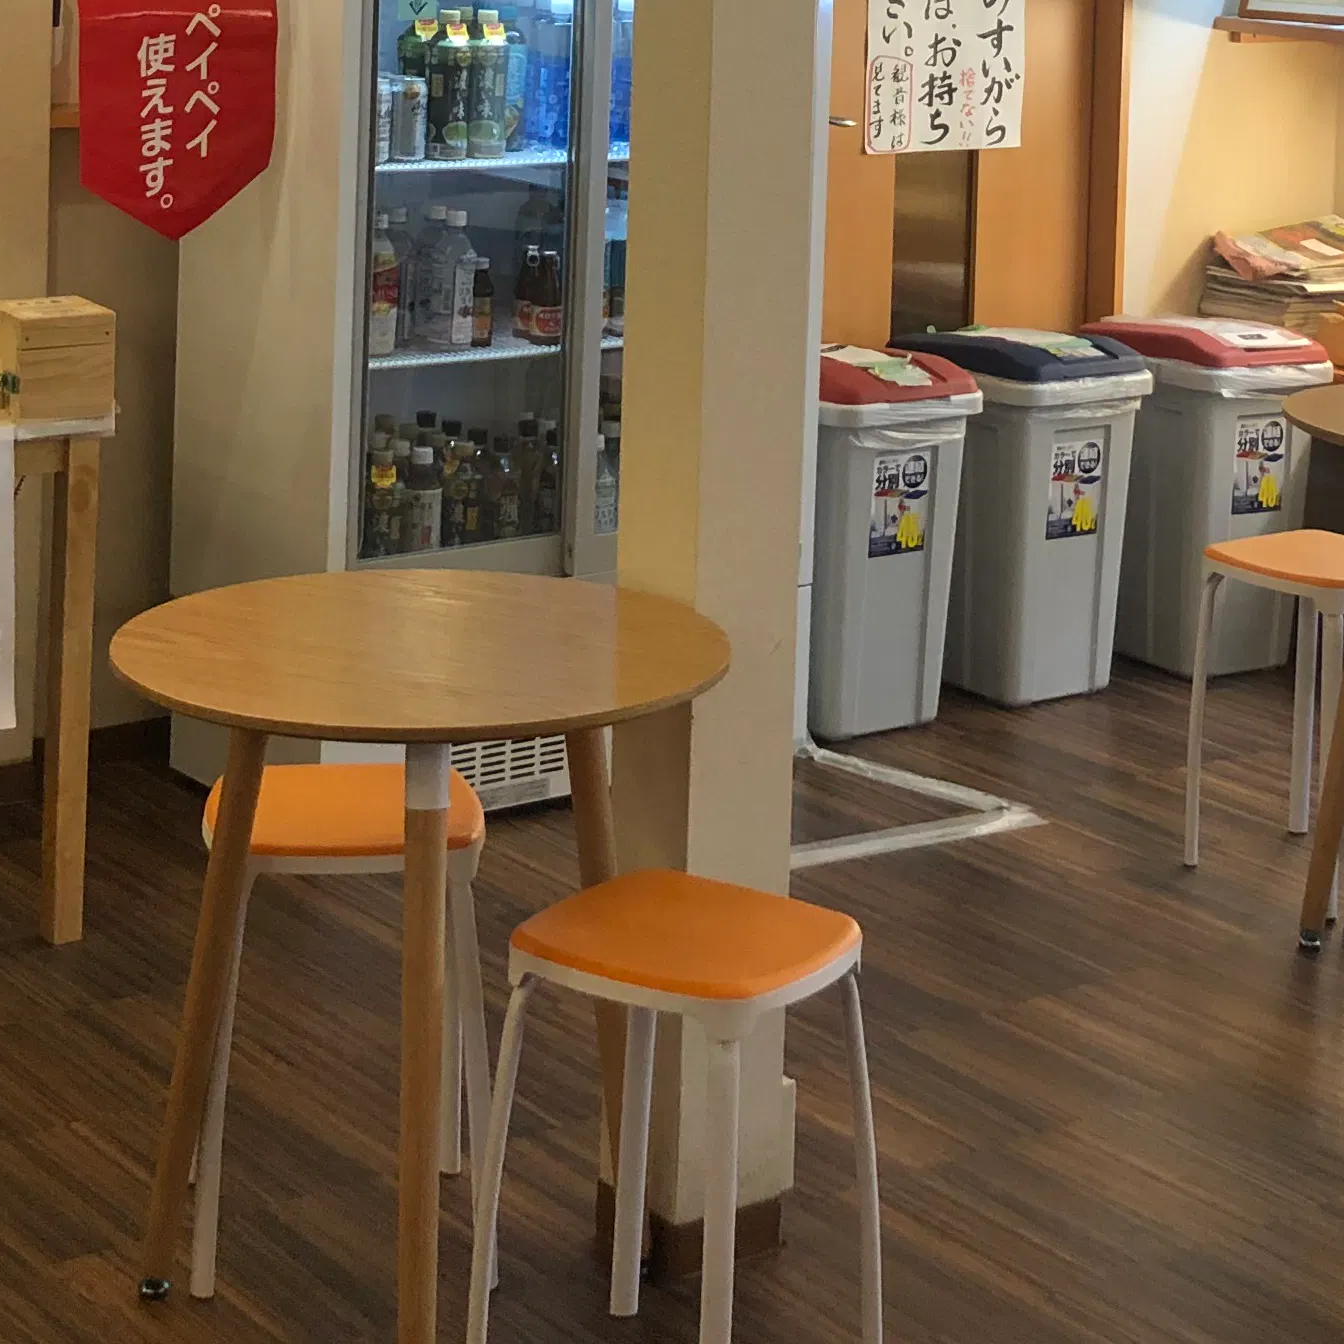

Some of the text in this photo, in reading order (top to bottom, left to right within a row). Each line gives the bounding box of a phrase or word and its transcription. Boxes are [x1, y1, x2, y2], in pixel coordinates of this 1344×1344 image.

[137, 32, 176, 209] 使えます。
[185, 3, 222, 158] ペイペイ
[869, 61, 885, 139] 見てます
[889, 63, 910, 150] 観音様は
